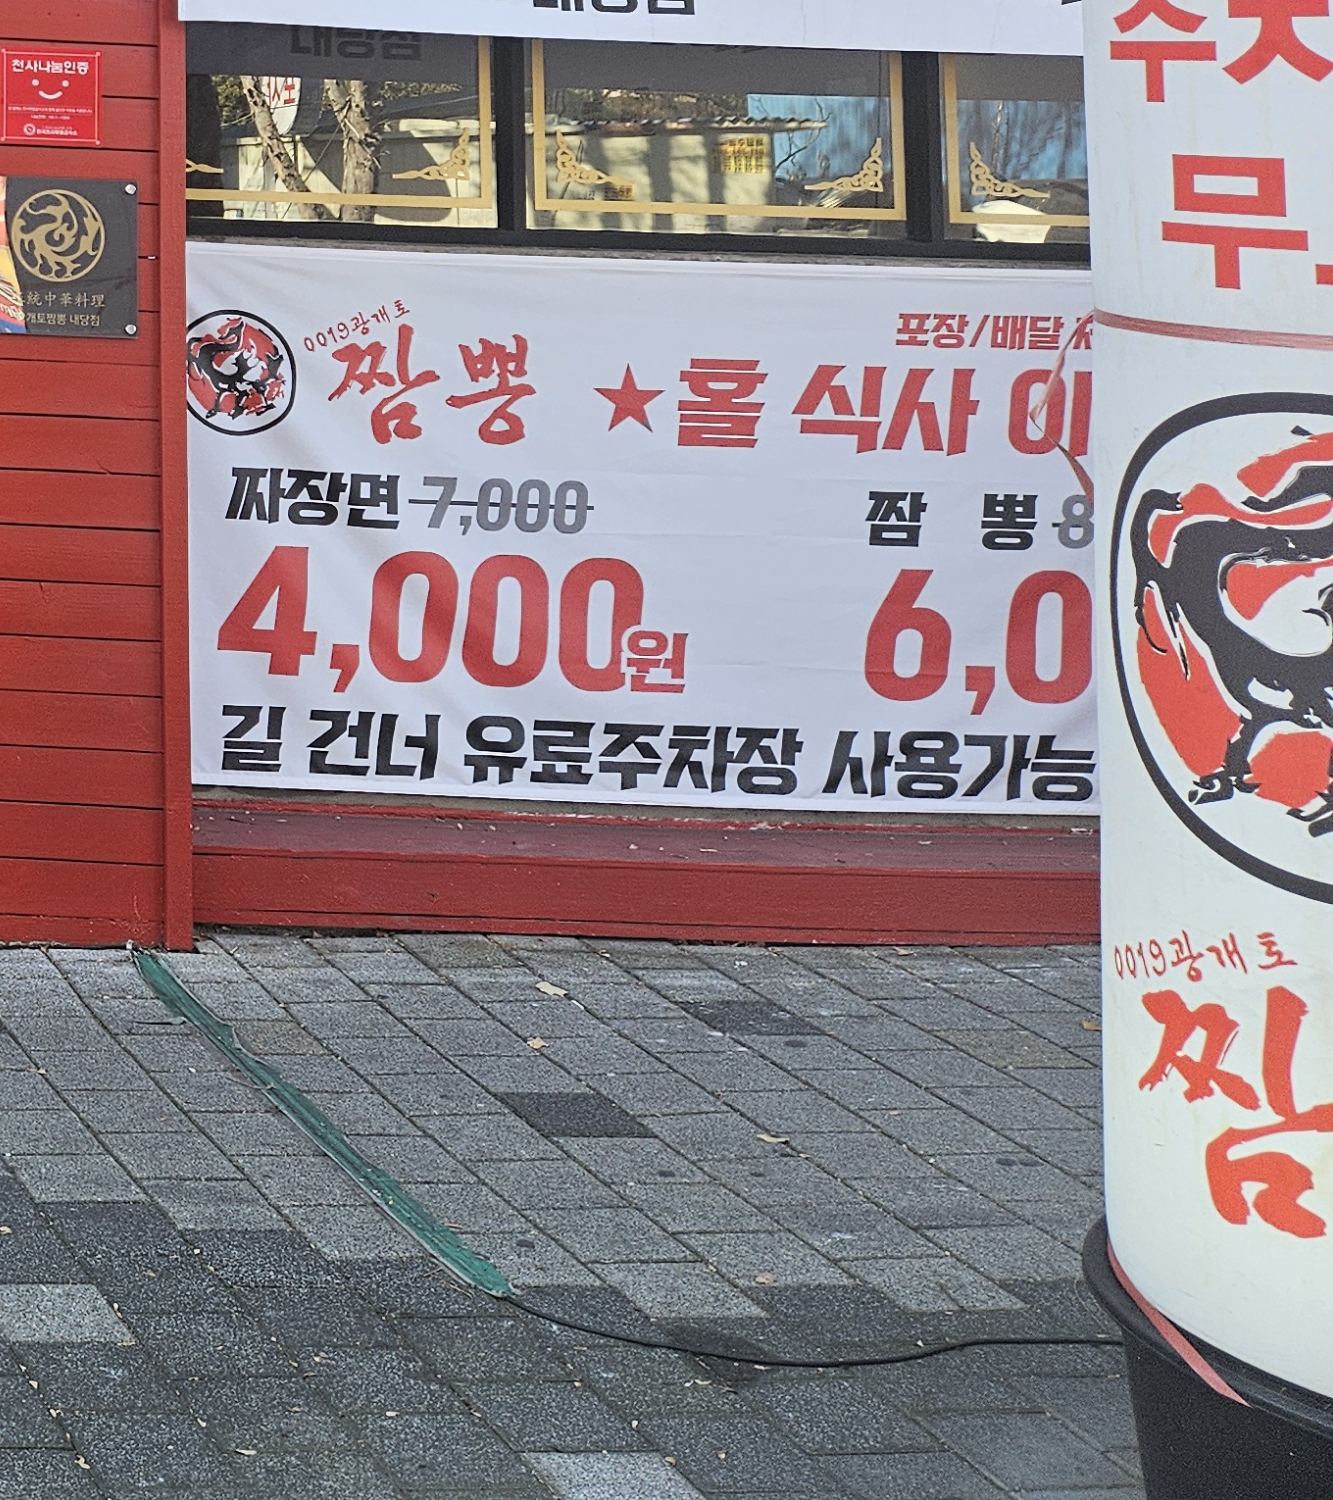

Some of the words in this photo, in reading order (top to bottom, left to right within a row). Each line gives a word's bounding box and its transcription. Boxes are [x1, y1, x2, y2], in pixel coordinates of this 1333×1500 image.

[12, 59, 89, 75] 천사나눔인증
[304, 300, 411, 353] 0019광개토
[895, 312, 1064, 352] 포장/배달
[676, 357, 770, 449] 홀
[792, 364, 981, 457] 식사
[224, 466, 401, 531] 짜장면
[415, 475, 592, 535] 7,000
[220, 703, 287, 773] 길
[308, 706, 441, 782] 건너
[464, 712, 802, 795] 유료주차장
[823, 727, 1095, 802] 사용가능
[1113, 930, 1298, 983] 0019광개토
